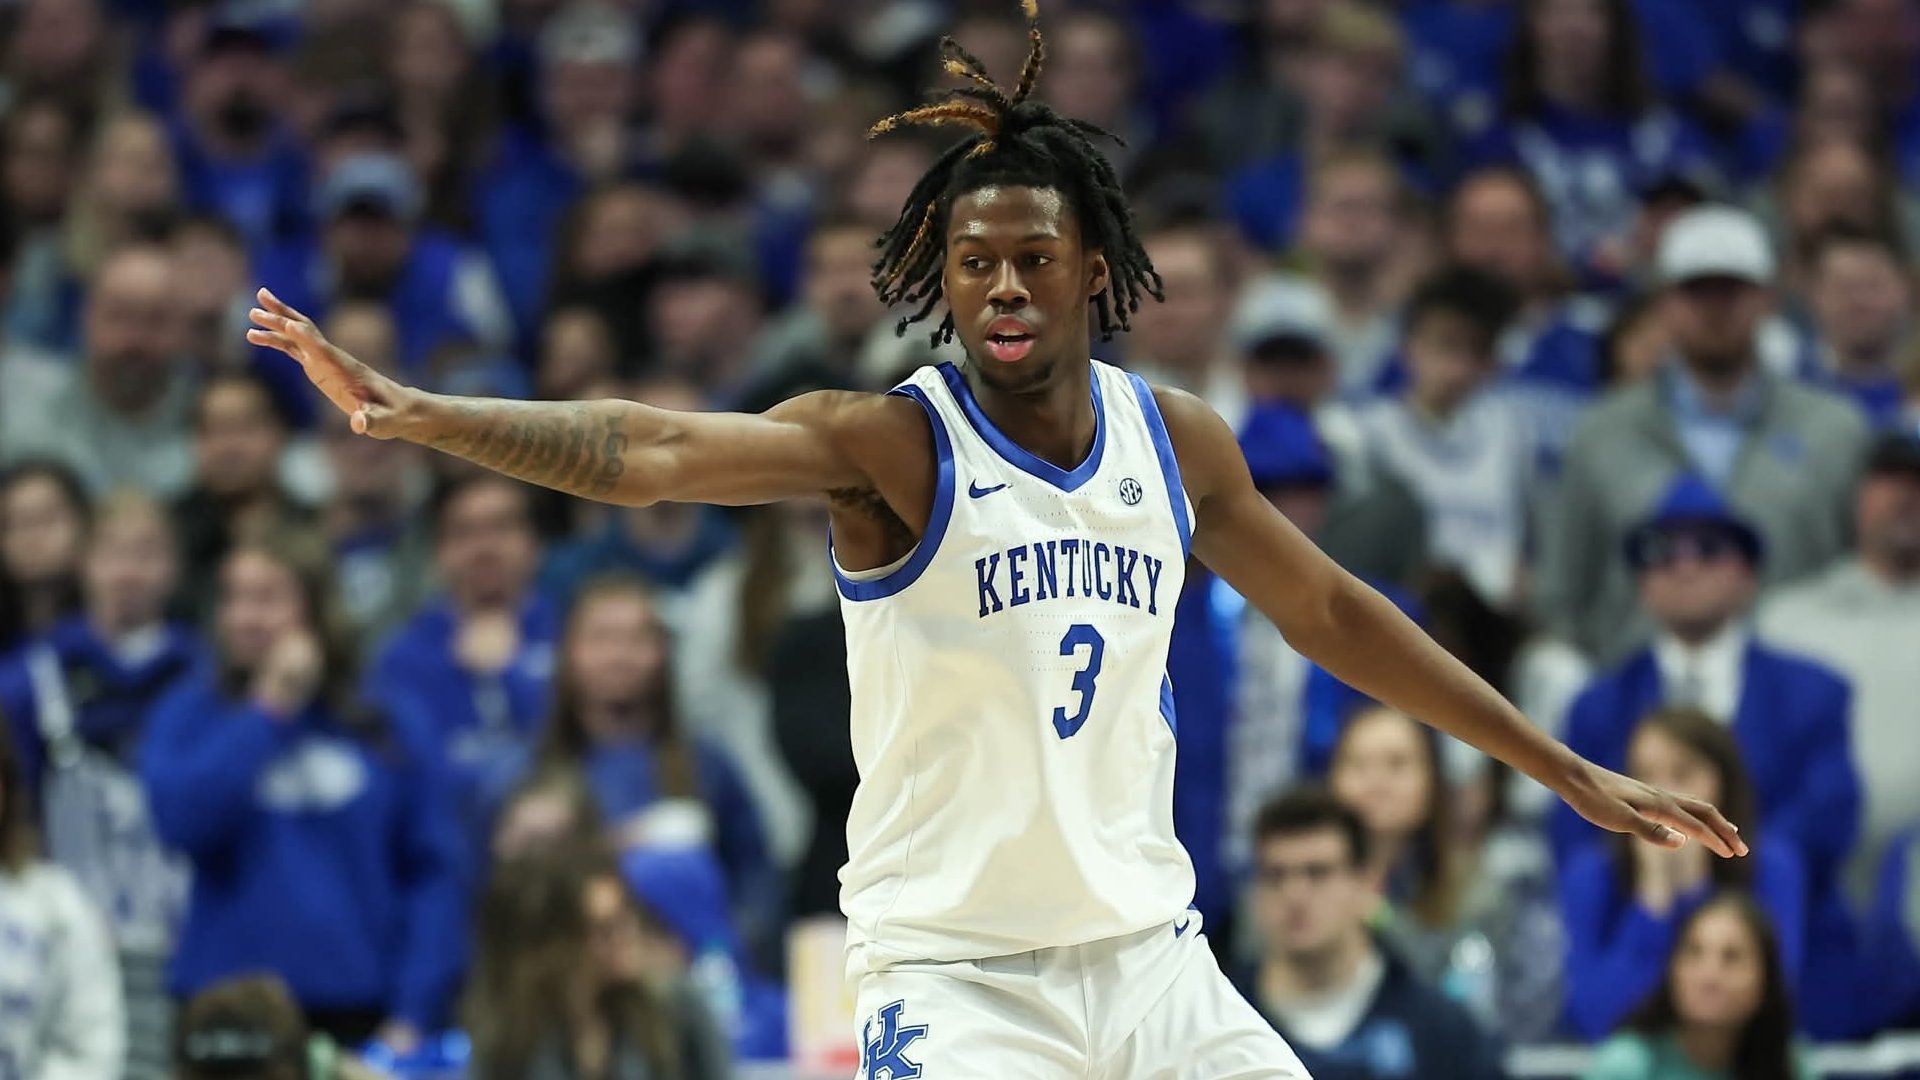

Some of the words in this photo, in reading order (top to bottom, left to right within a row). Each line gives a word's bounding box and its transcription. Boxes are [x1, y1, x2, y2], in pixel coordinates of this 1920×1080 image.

[1120, 479, 1142, 504] SEC
[975, 539, 1162, 618] KENTUCKY
[1052, 624, 1105, 740] 3
